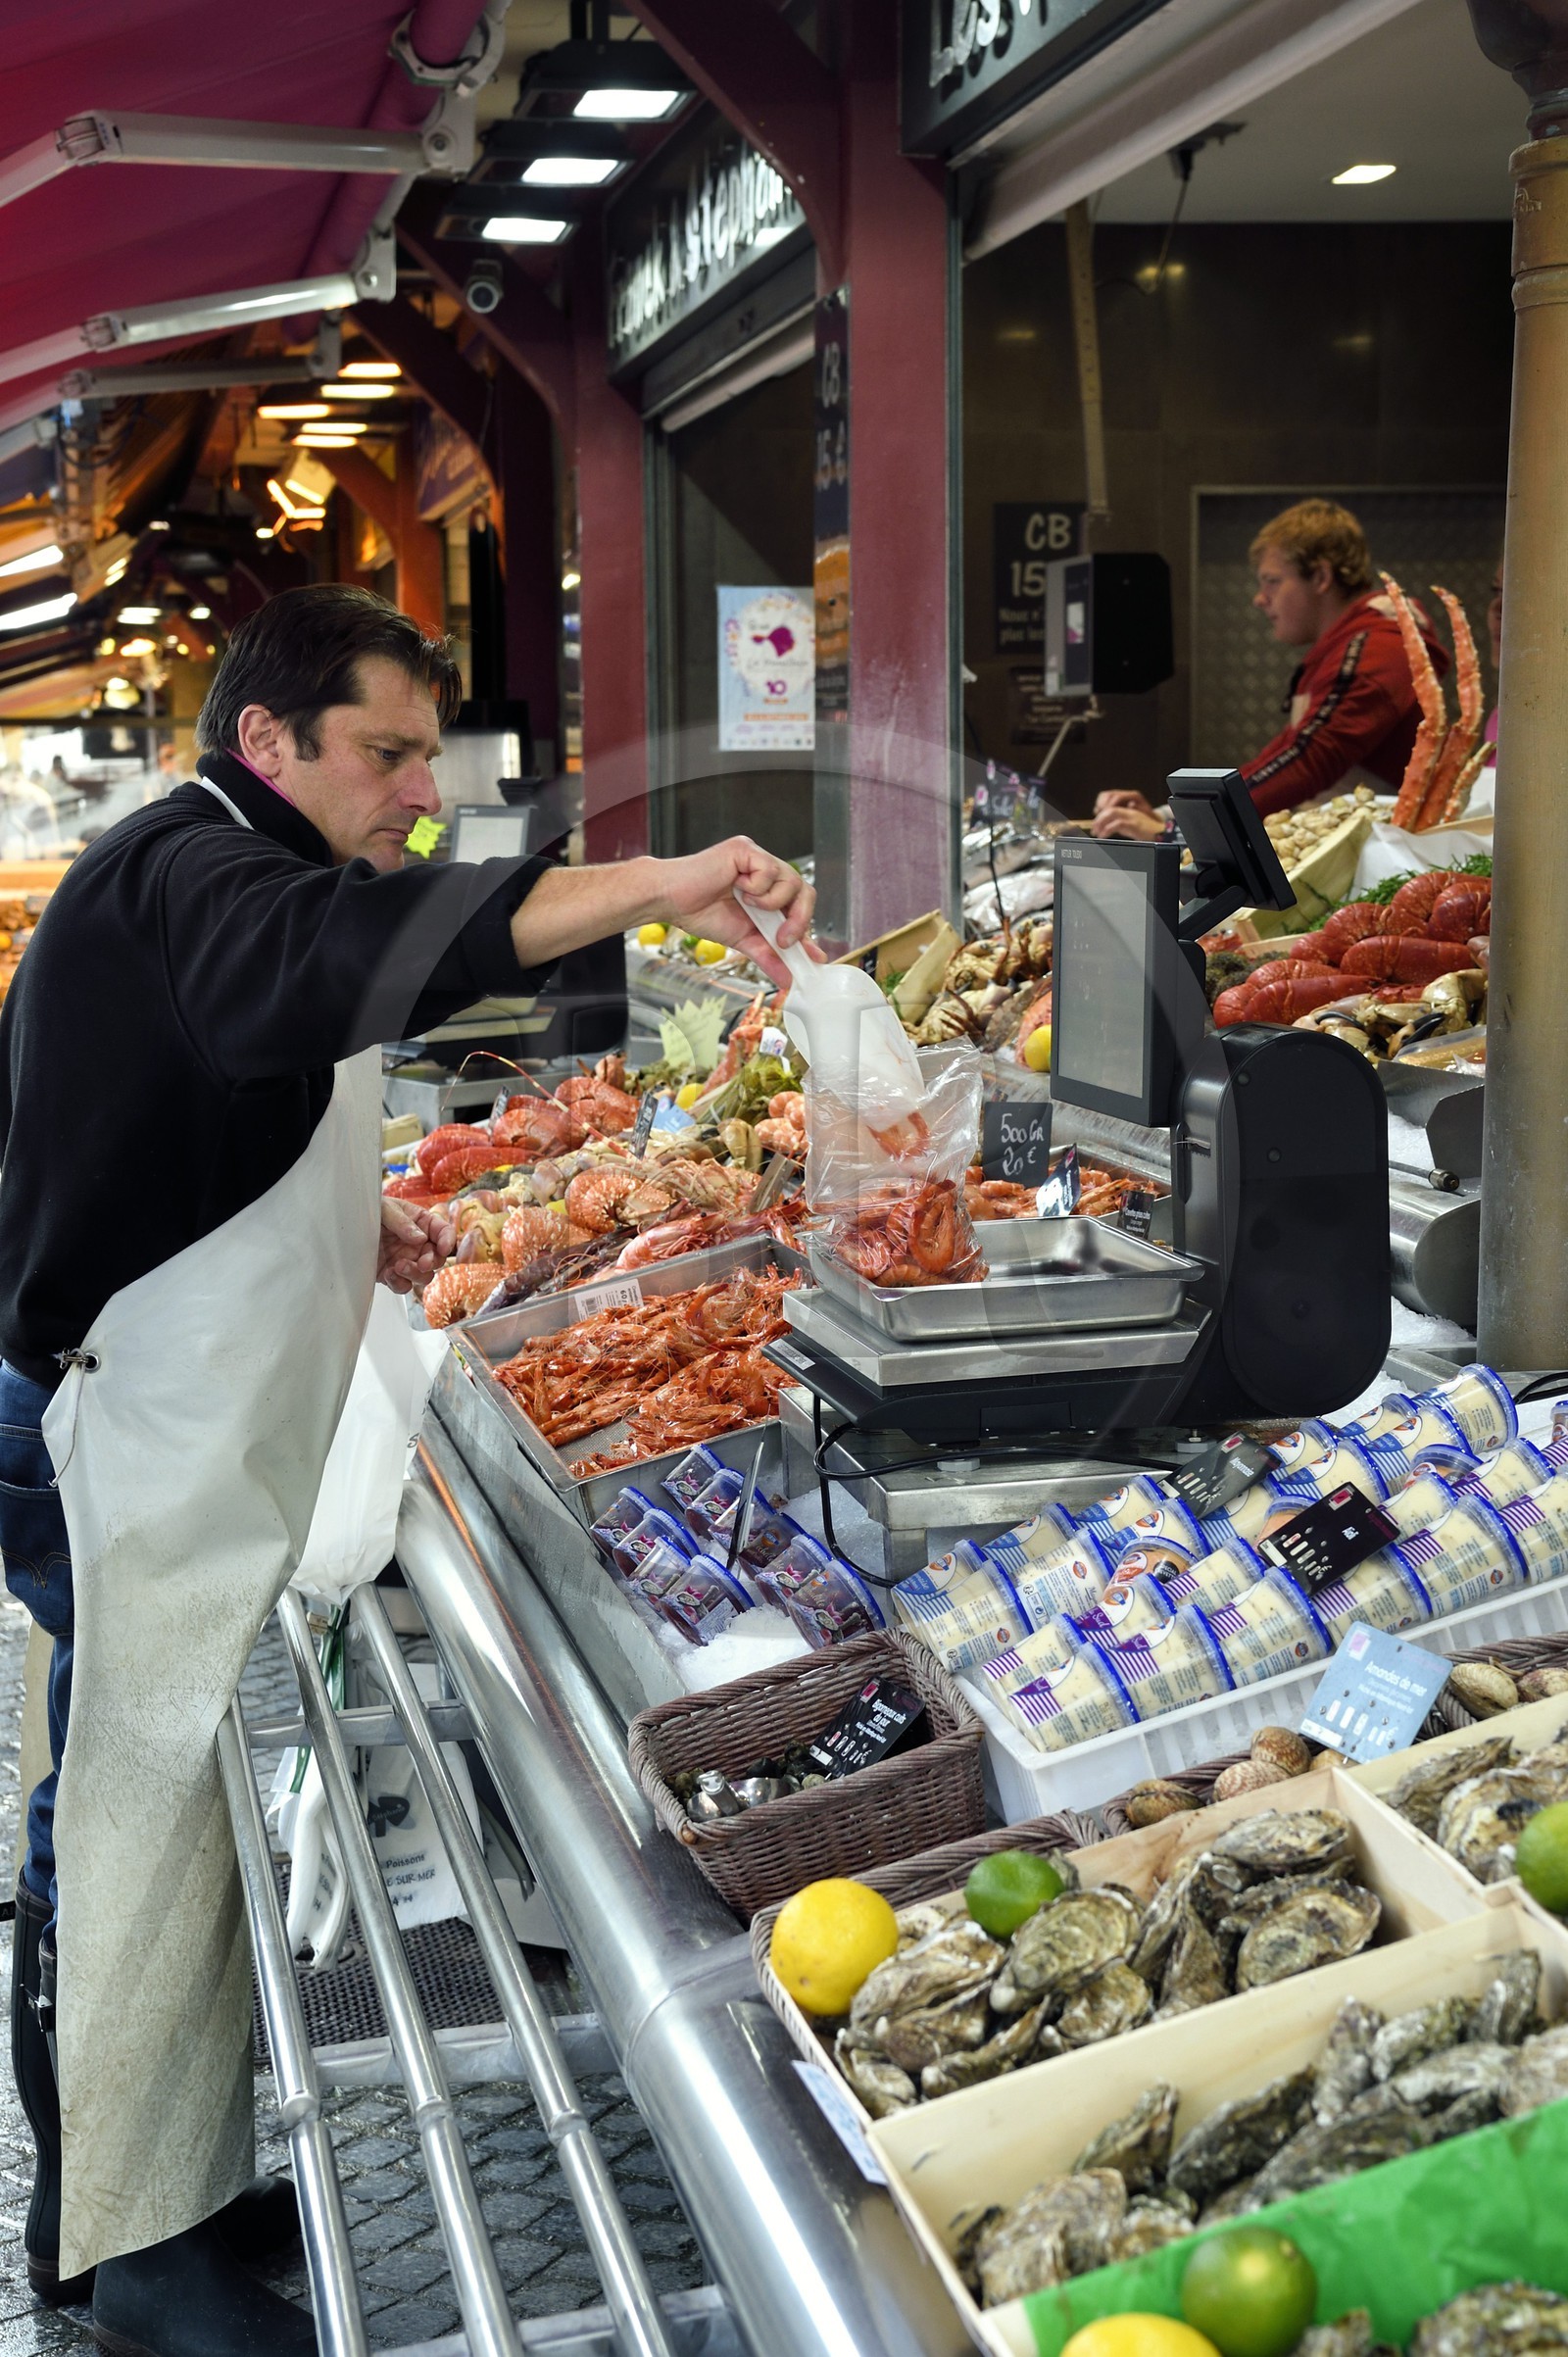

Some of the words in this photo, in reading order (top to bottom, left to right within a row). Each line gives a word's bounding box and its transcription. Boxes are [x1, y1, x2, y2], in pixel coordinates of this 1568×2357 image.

[1024, 511, 1072, 552] CB
[1364, 1660, 1400, 1686] Amandes
[1398, 1676, 1411, 1691] de
[1409, 1683, 1427, 1697] mer
[894, 1713, 906, 1725] cuits
[386, 1852, 425, 1869] Poissons
[396, 1874, 416, 1886] SUR
[417, 1868, 436, 1882] MER
